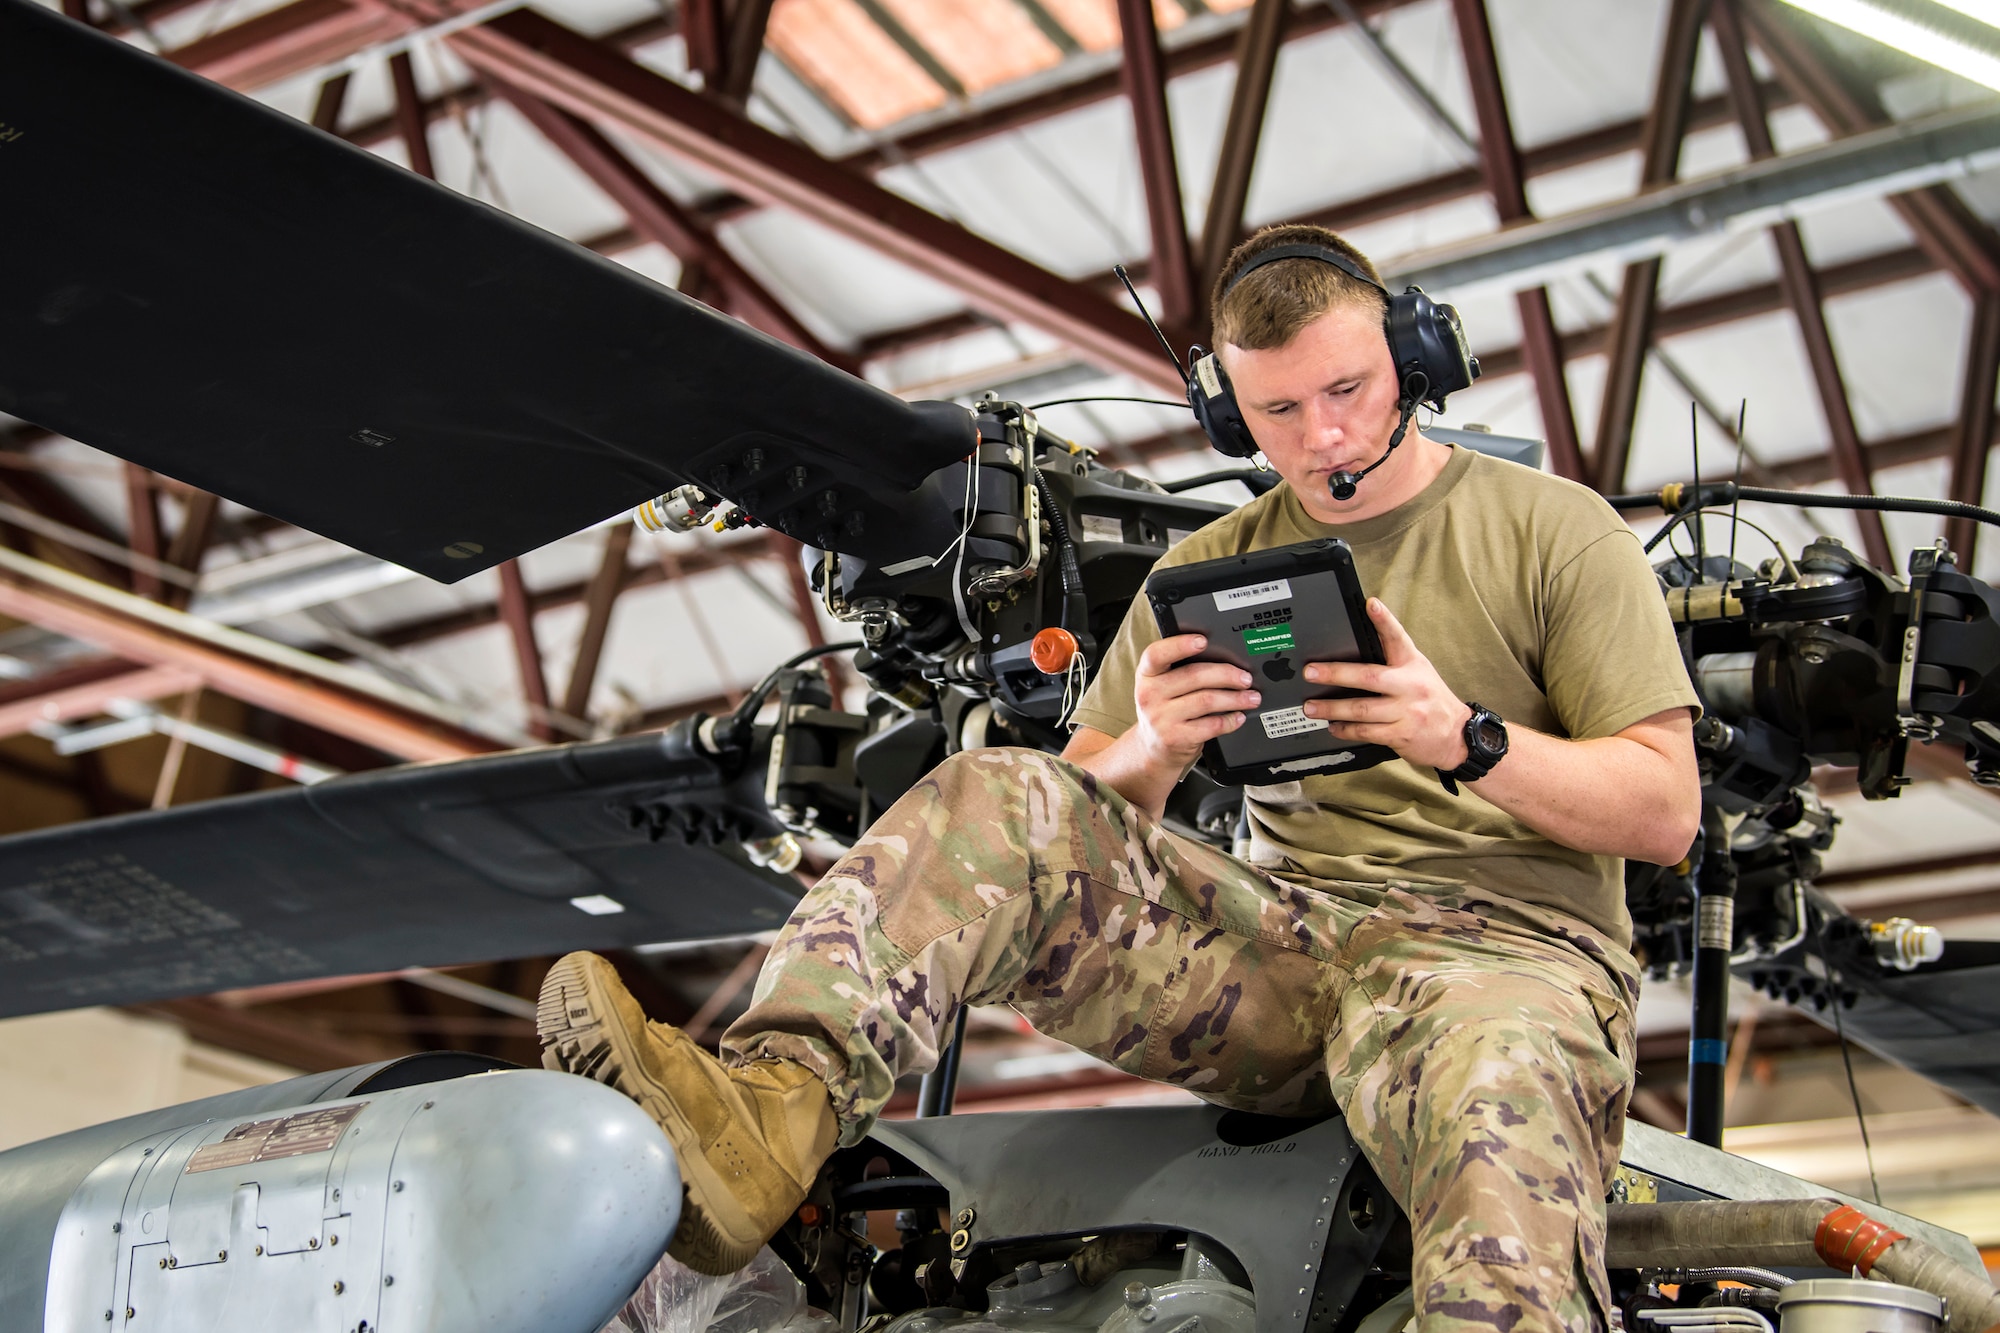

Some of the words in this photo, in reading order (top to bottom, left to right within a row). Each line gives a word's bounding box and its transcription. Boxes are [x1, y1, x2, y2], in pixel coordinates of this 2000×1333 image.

[1232, 615, 1293, 632] LIFEPROOF
[1246, 633, 1292, 645] UNCLASSIFIED
[1197, 1146, 1241, 1158] HAND
[1250, 1142, 1297, 1155] HOLD
